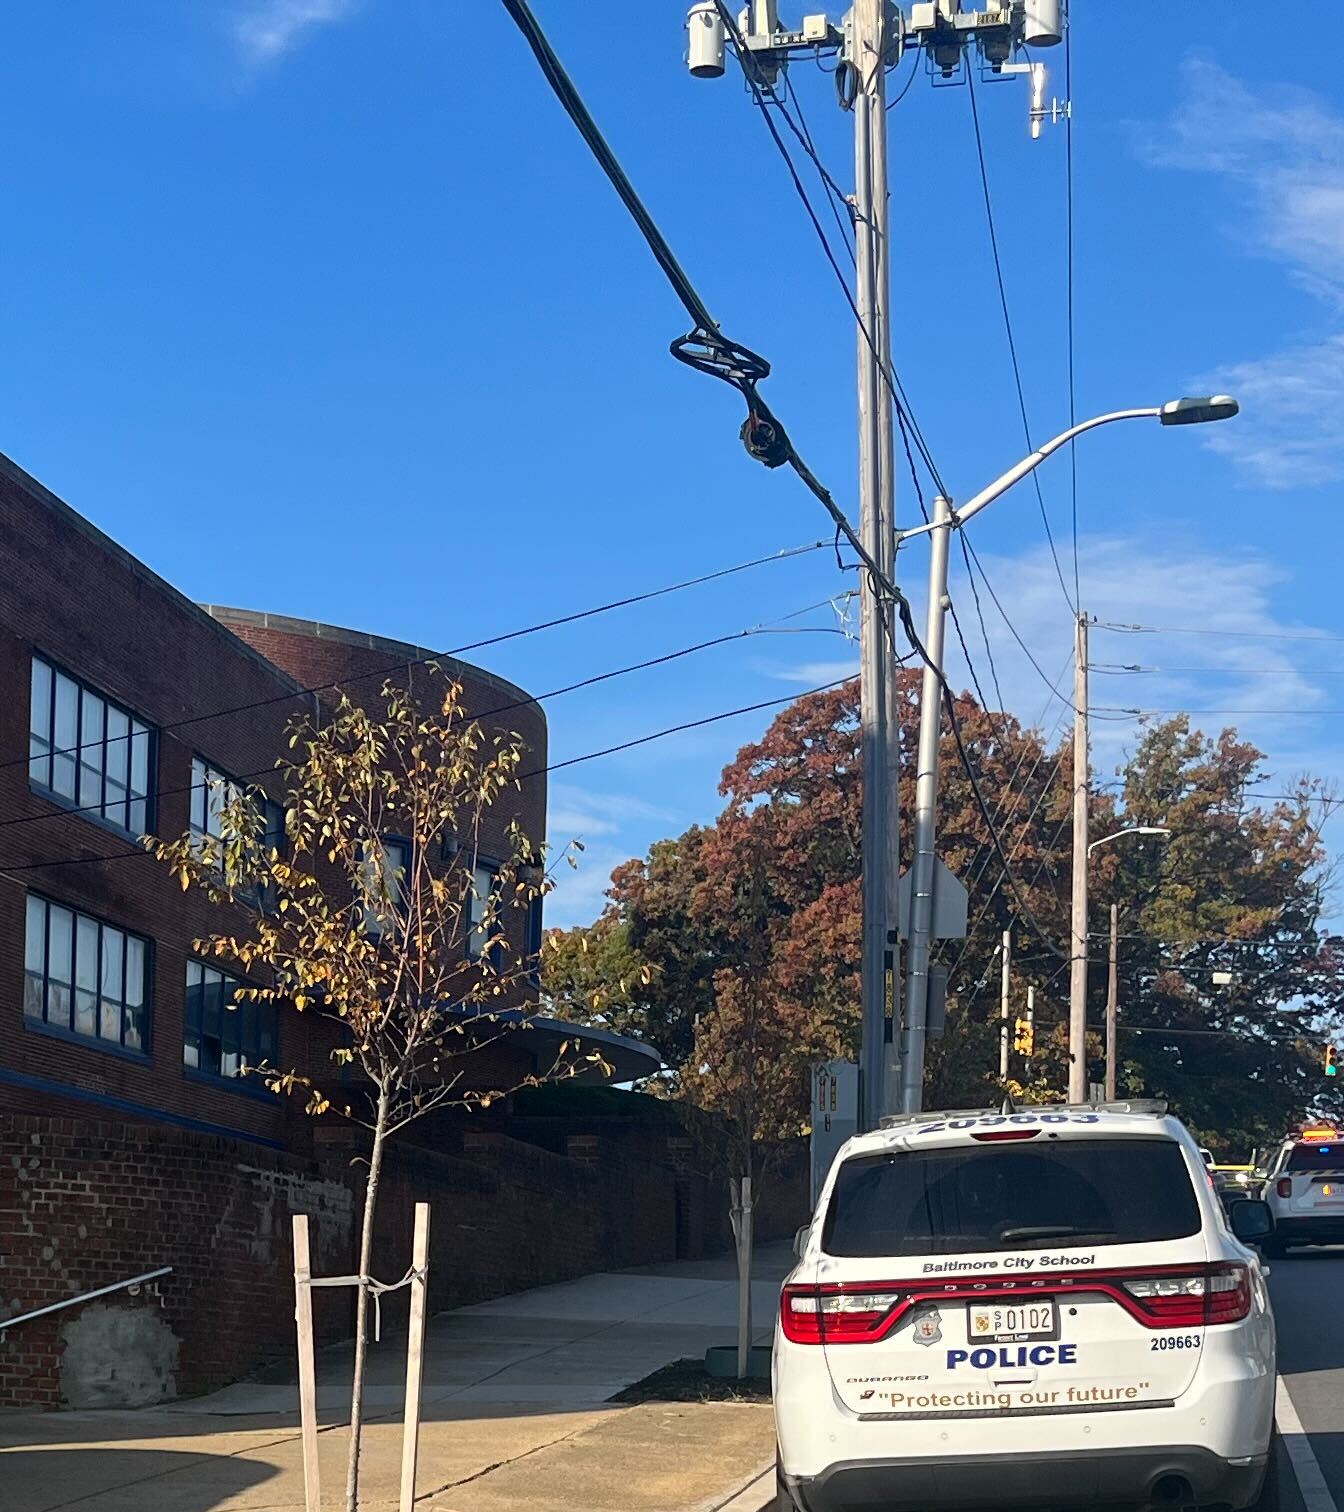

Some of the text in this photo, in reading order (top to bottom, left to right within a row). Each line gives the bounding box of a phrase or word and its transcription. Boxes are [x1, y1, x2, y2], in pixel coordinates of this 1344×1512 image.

[923, 1254, 1095, 1273] Baltimore City School
[1007, 1308, 1050, 1330] 0102
[1150, 1335, 1201, 1351] 209663
[946, 1343, 1077, 1369] POLICE
[1020, 1391, 1060, 1404] our
